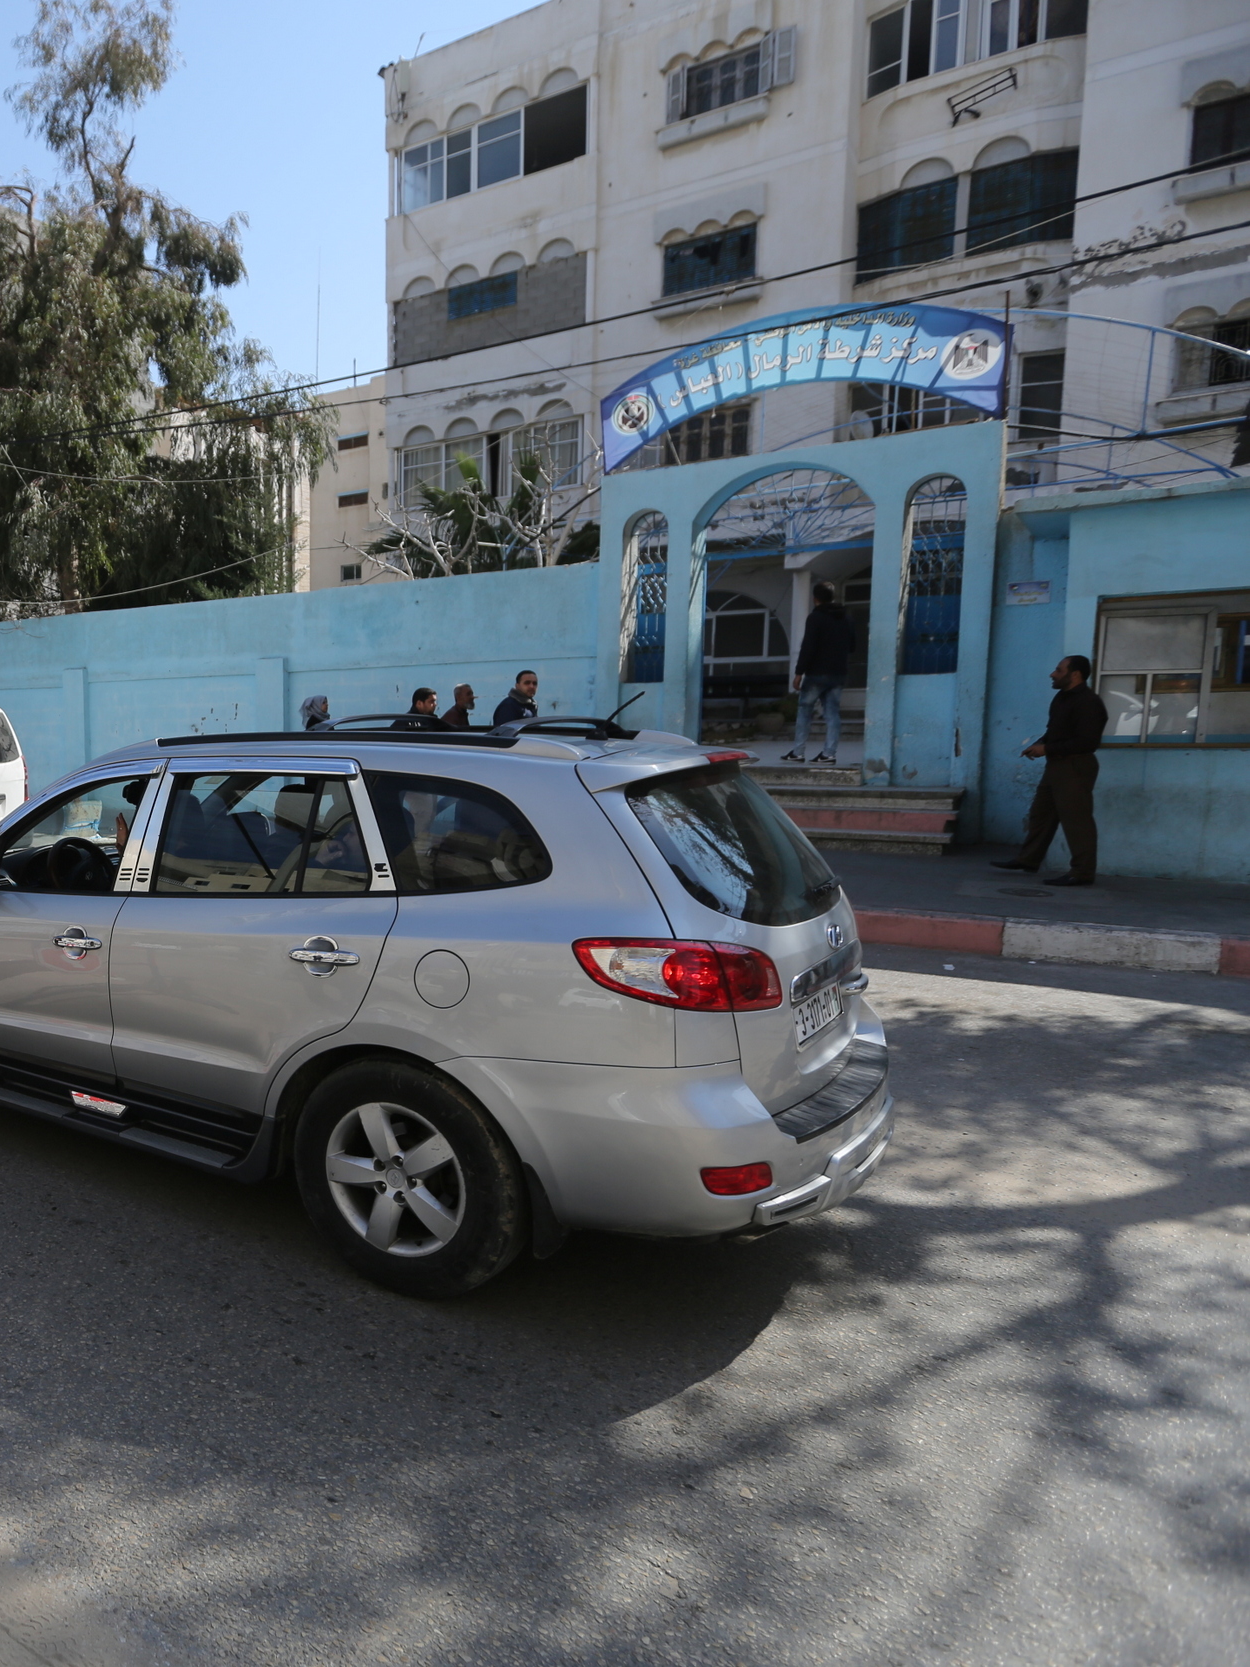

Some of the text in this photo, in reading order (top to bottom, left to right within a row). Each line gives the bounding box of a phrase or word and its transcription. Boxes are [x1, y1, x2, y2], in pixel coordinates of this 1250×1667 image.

[835, 311, 885, 329] الداخلية
[886, 311, 916, 328] وزارة
[747, 343, 813, 379] الرمال
[816, 334, 883, 365] شرطة
[880, 336, 939, 366] مركز
